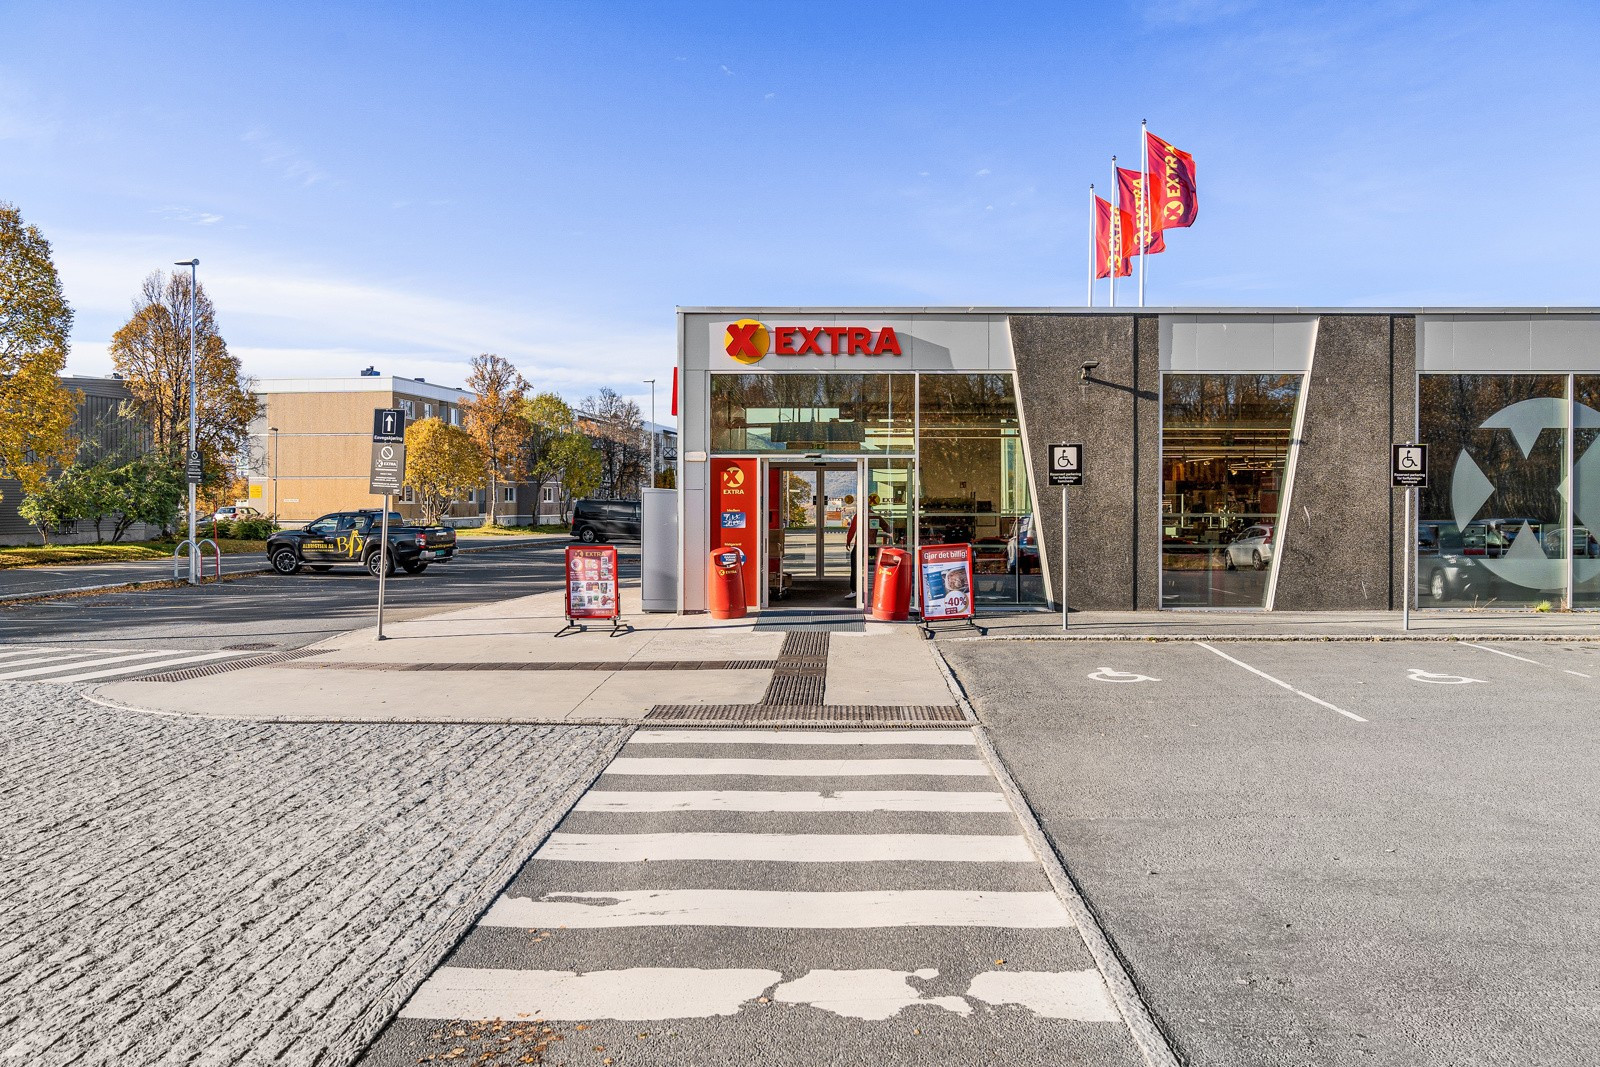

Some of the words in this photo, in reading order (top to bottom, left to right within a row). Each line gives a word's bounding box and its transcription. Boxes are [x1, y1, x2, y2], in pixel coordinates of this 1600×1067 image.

[774, 326, 903, 357] EXTRA
[950, 550, 967, 559] billig!
[945, 597, 966, 606] -40%
